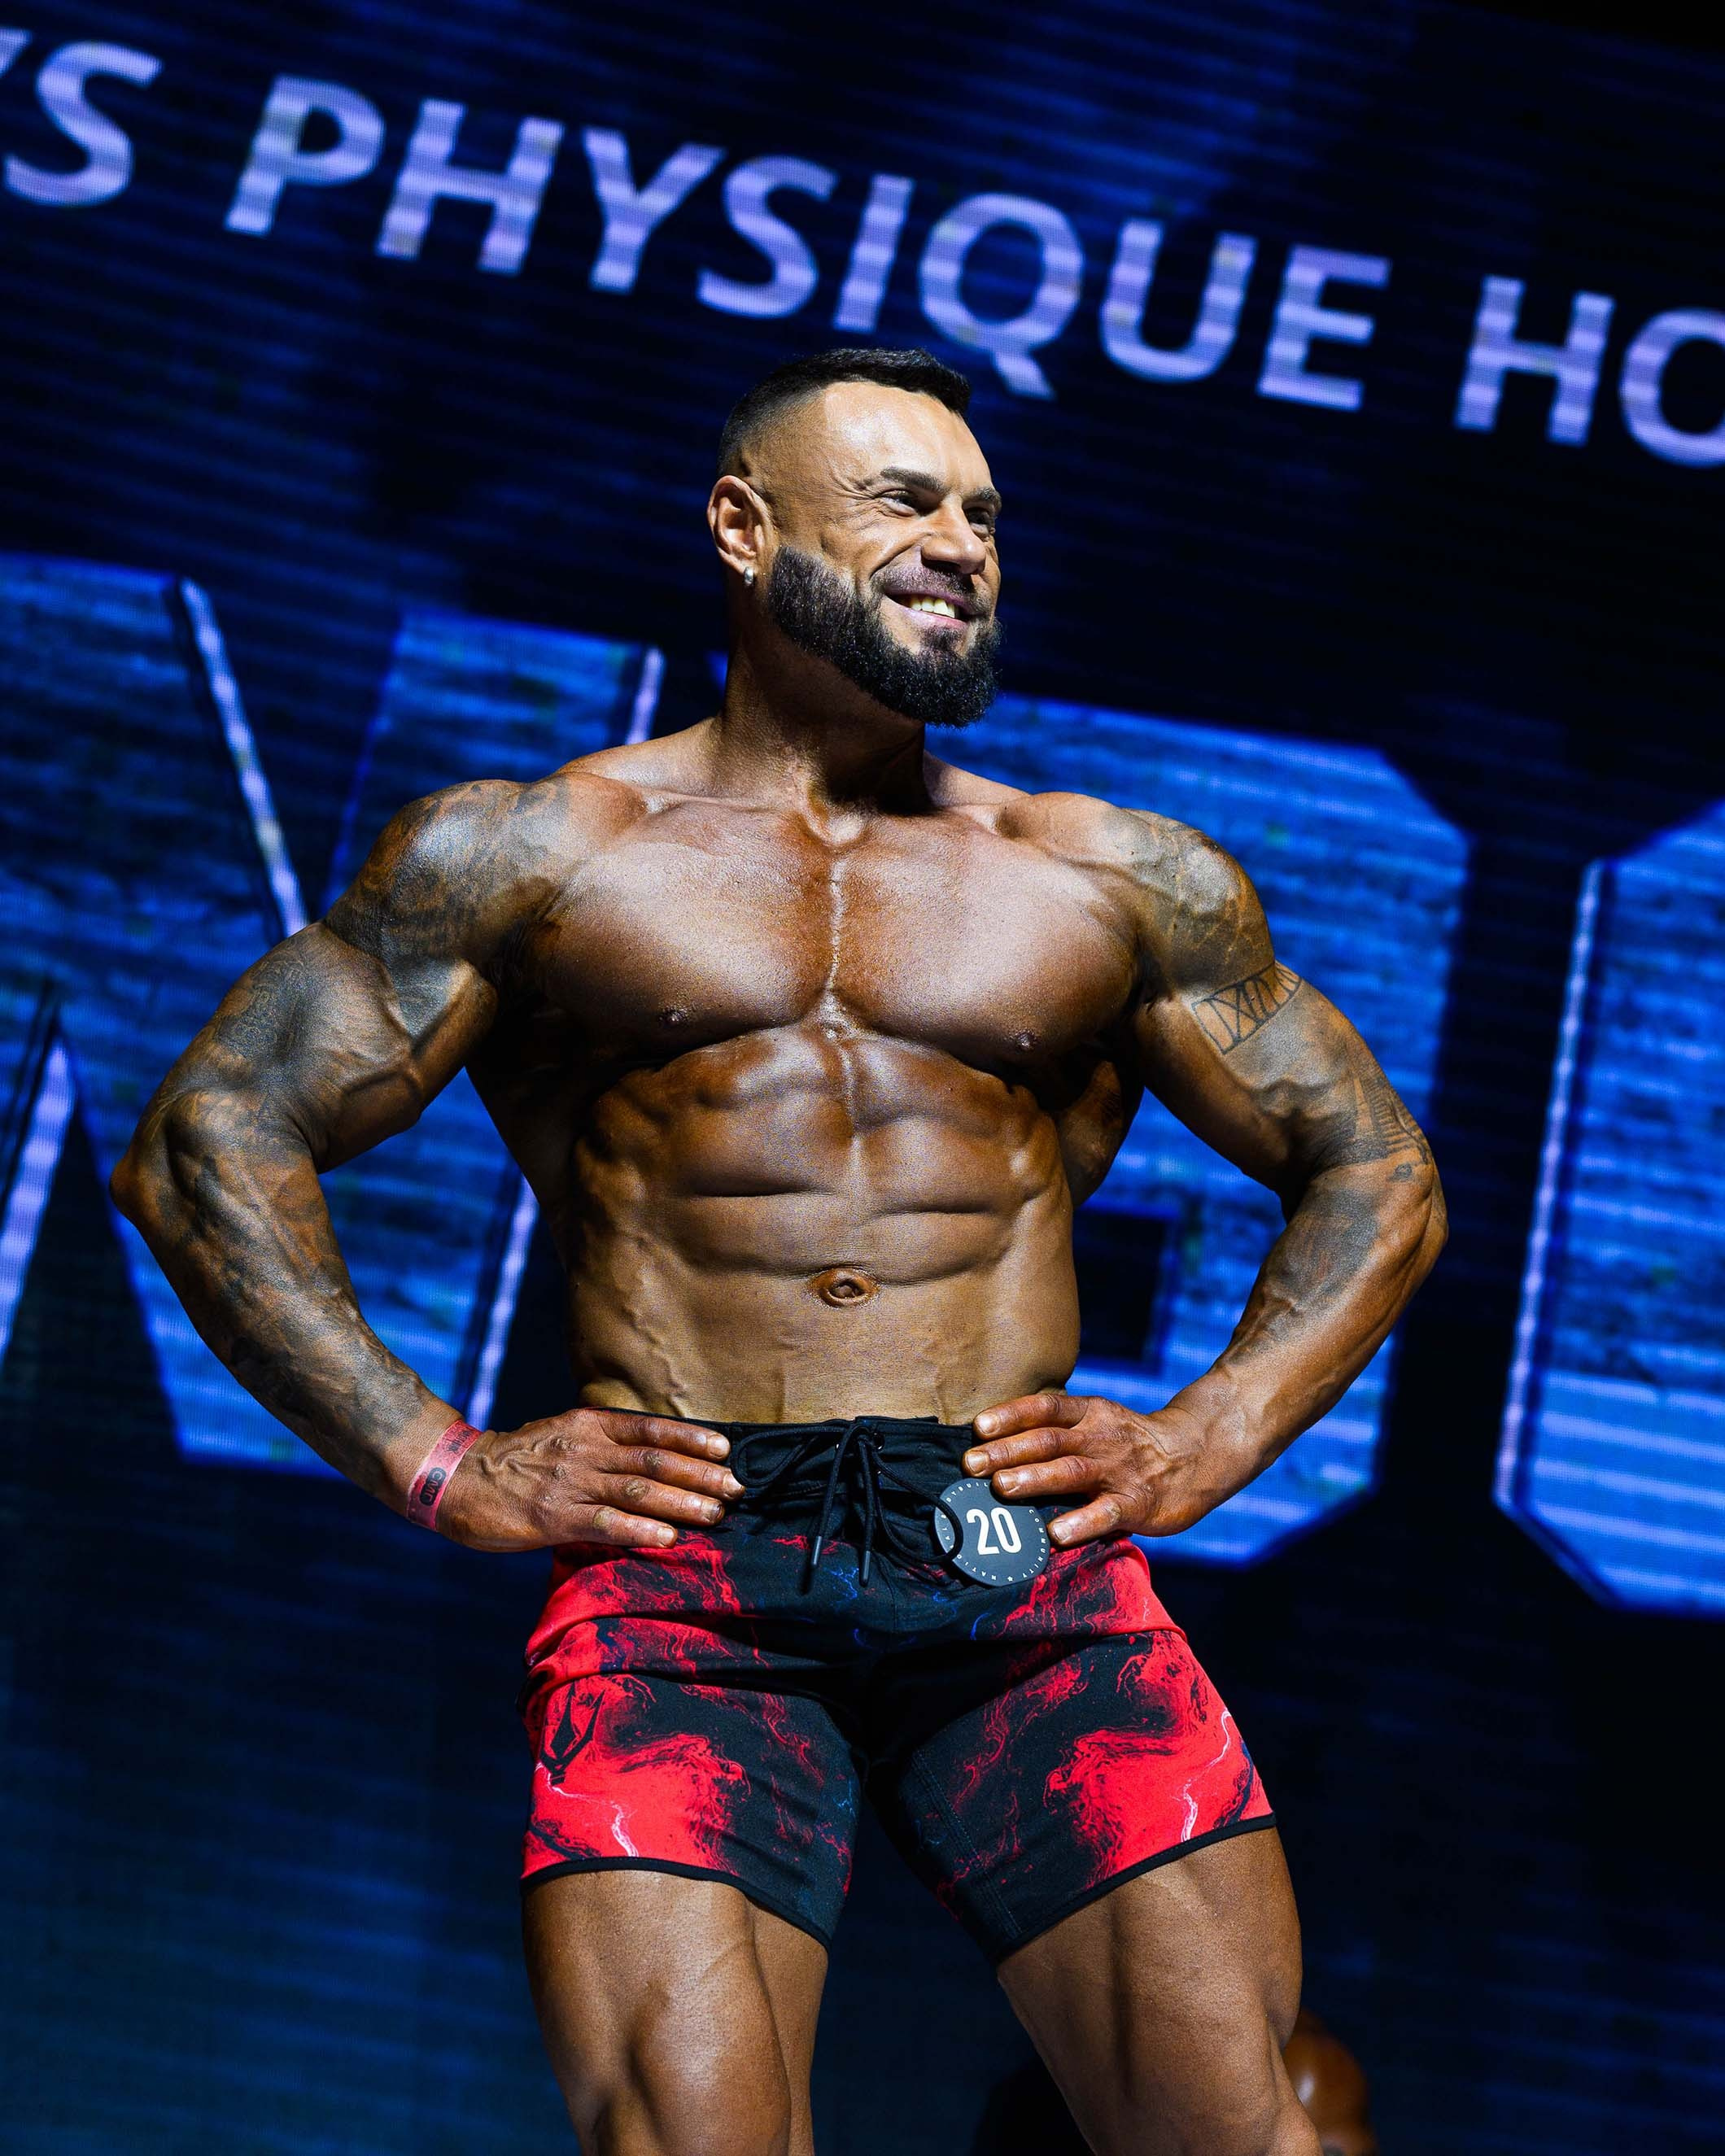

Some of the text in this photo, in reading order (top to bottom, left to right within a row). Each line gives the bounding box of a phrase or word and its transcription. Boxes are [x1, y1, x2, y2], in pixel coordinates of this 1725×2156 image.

[224, 74, 1391, 411] PHYSIQUE
[966, 1507, 1022, 1556] 20
[1022, 1509, 1047, 1578] COMMUNITY
